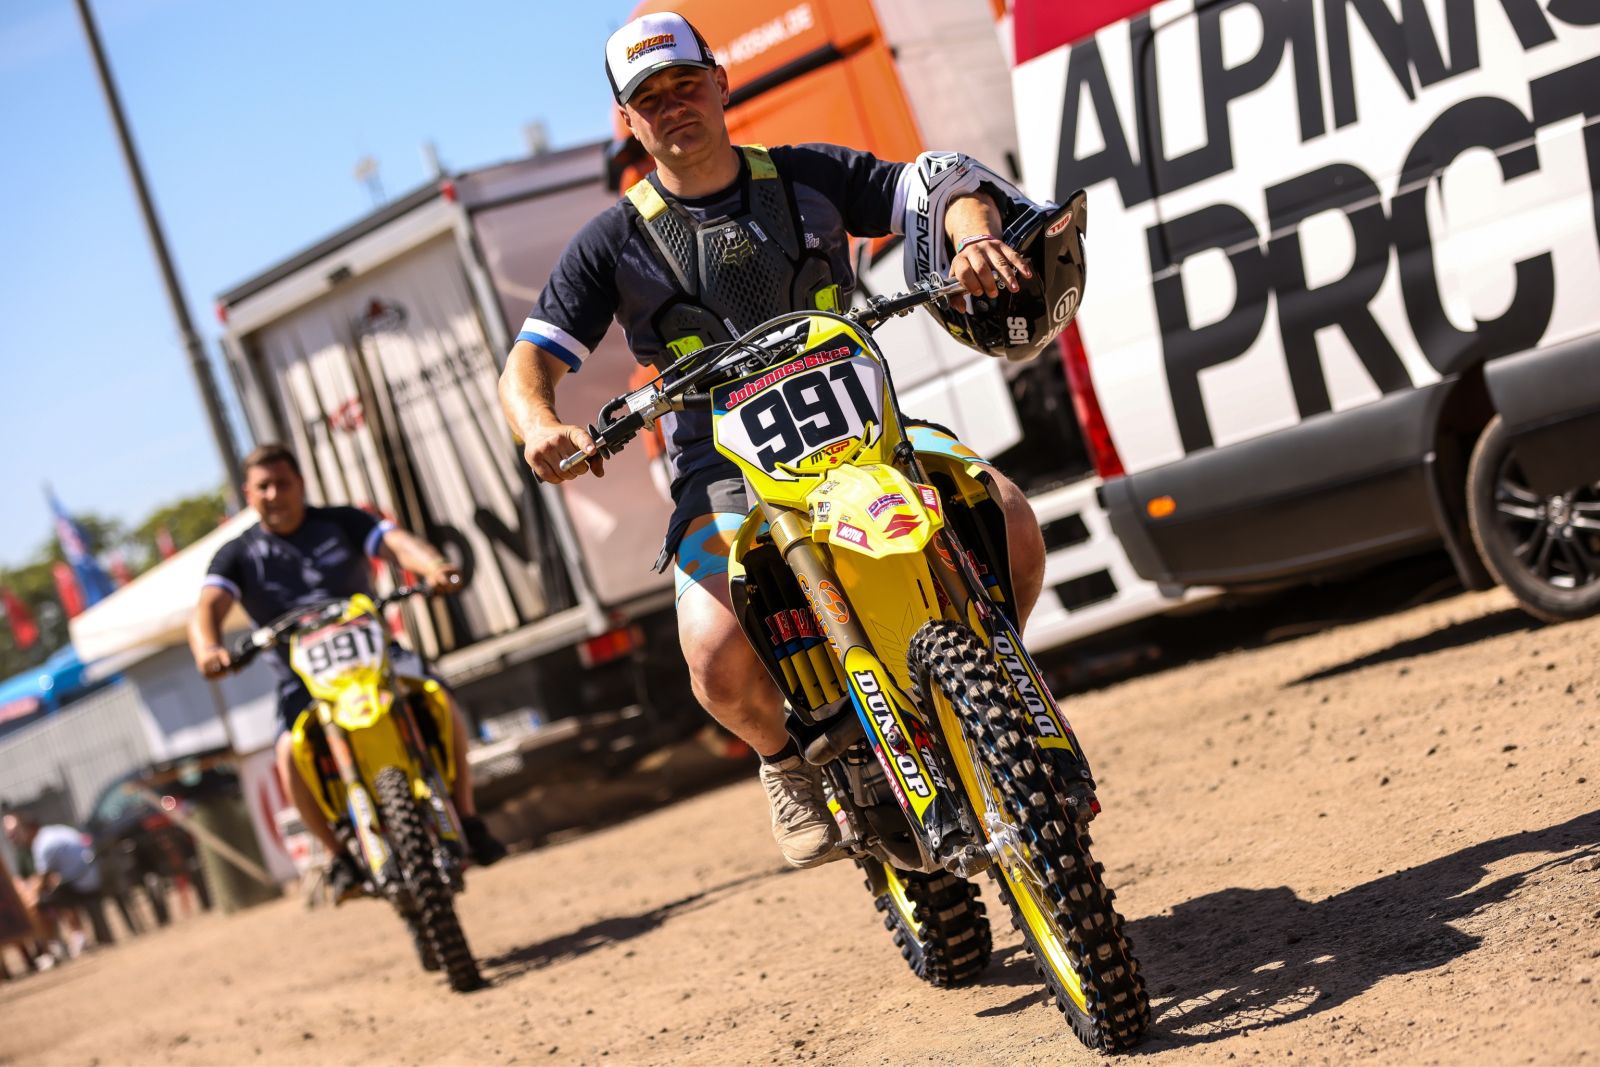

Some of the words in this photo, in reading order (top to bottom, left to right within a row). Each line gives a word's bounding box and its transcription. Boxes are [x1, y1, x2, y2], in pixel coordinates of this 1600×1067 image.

[1007, 316, 1029, 344] 991
[725, 361, 805, 409] Johannes
[804, 346, 851, 369] Bikes
[740, 361, 879, 473] 991
[839, 525, 863, 544] MOTUL
[308, 625, 378, 675] 991
[993, 631, 1063, 738] DUNLO
[852, 670, 931, 797] DUNOP
[876, 752, 907, 806] MOTUL
